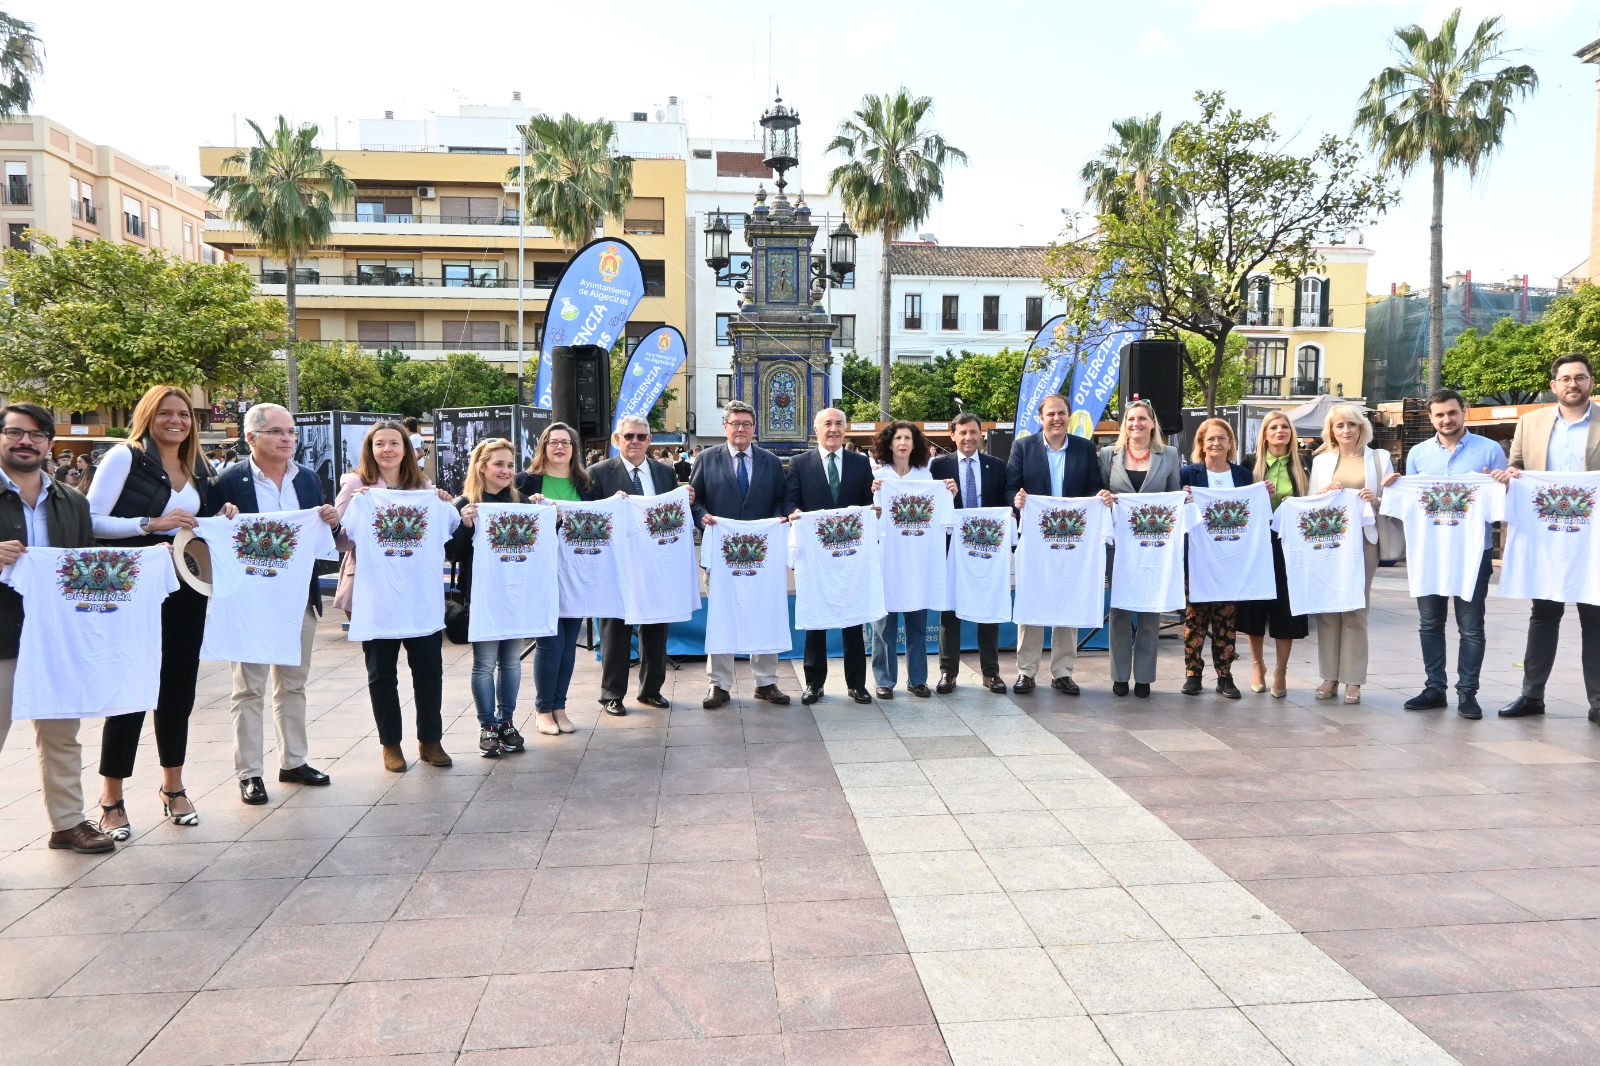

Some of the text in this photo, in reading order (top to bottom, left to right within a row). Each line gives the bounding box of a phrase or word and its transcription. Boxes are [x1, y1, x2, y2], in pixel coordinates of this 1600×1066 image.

[580, 278, 631, 297] Ayuntamiento
[578, 288, 629, 306] de Algeciras
[239, 557, 289, 570] DIVERCIENCIA
[252, 566, 269, 576] 2026
[65, 592, 132, 602] DIVERCIENCIA
[87, 602, 107, 612] 2026
